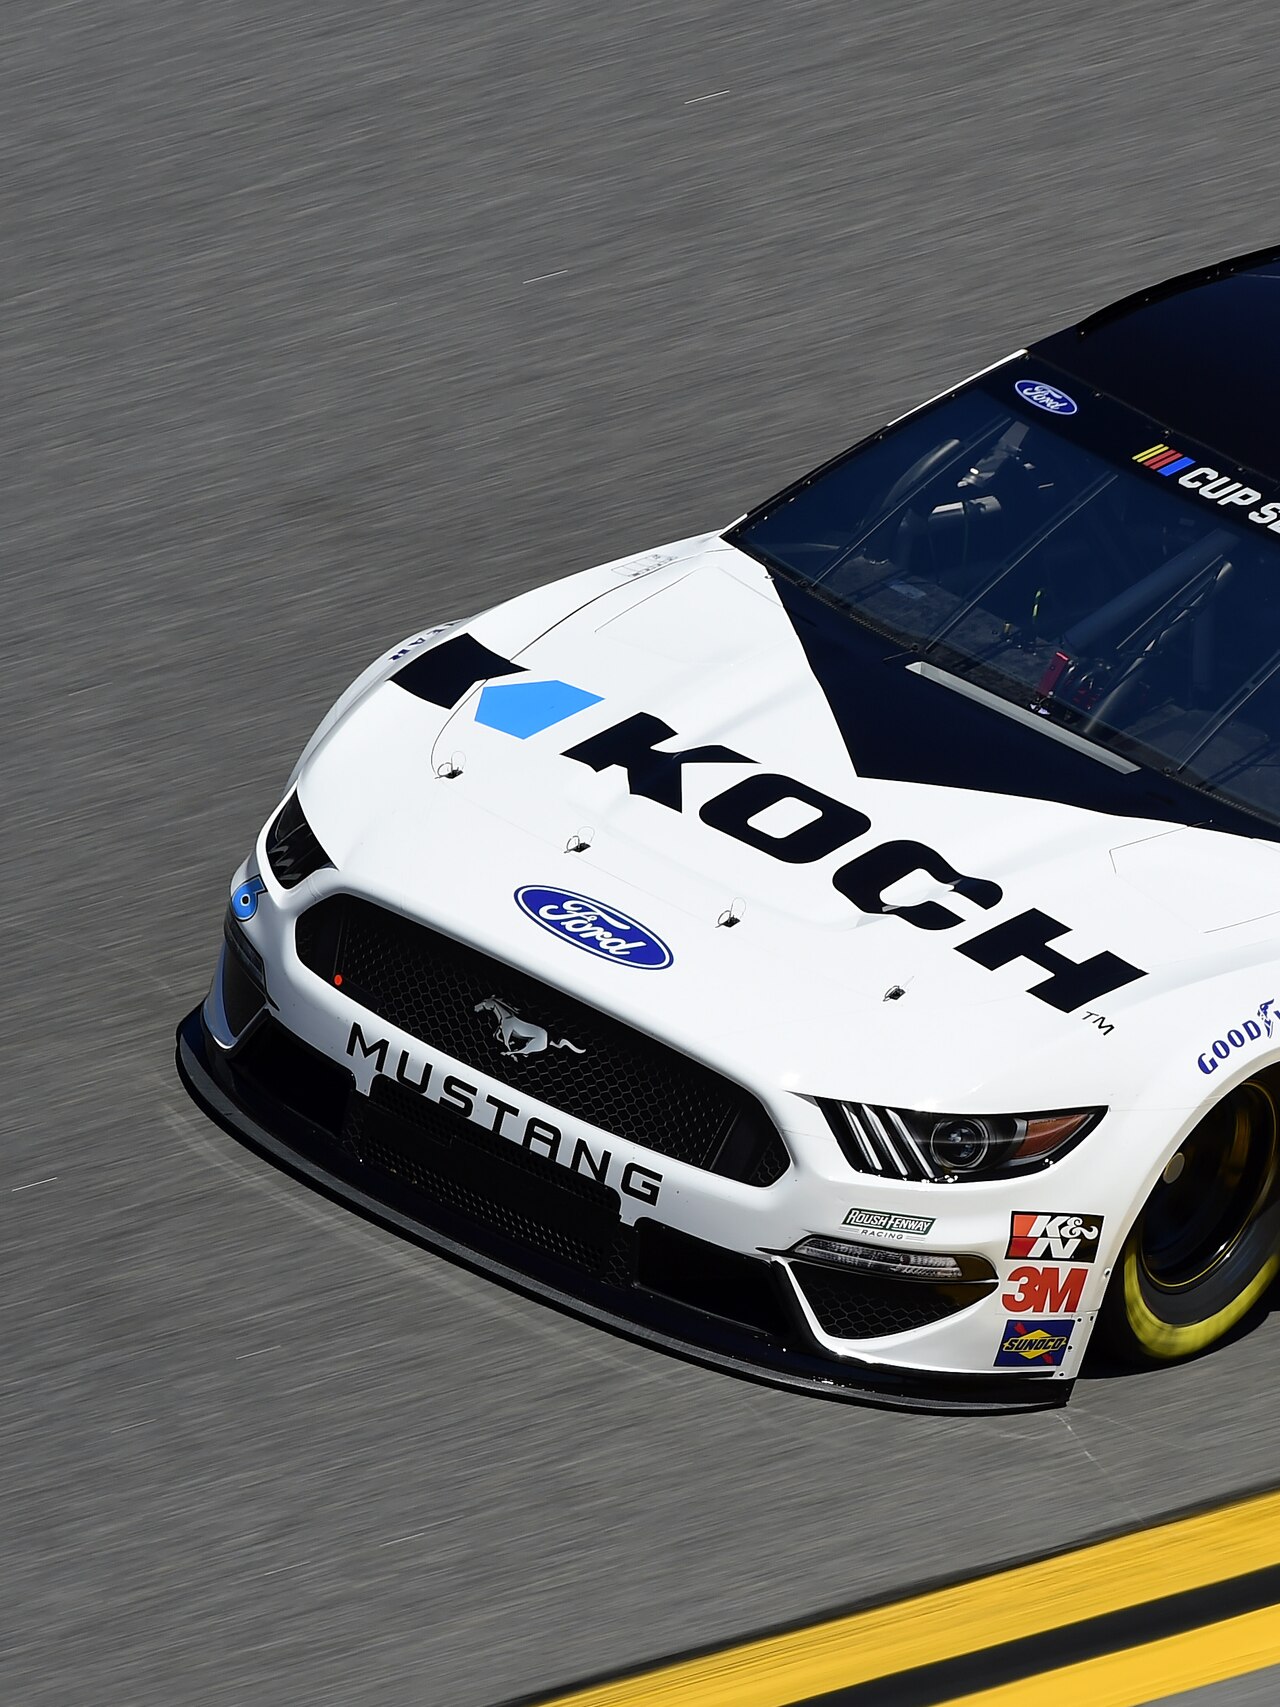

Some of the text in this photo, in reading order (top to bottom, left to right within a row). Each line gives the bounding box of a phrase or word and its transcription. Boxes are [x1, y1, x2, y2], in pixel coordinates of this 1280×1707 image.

[1023, 385, 1068, 410] Ford
[1178, 467, 1261, 506] CUP
[560, 712, 1150, 1014] KOCH
[231, 873, 269, 922] 6
[538, 900, 647, 955] Ford
[1082, 1010, 1115, 1036] TM
[345, 1021, 664, 1208] MUSTANG
[861, 1229, 904, 1240] RACING
[1001, 1265, 1089, 1313] 3M
[1004, 1337, 1066, 1351] SUNOCO
